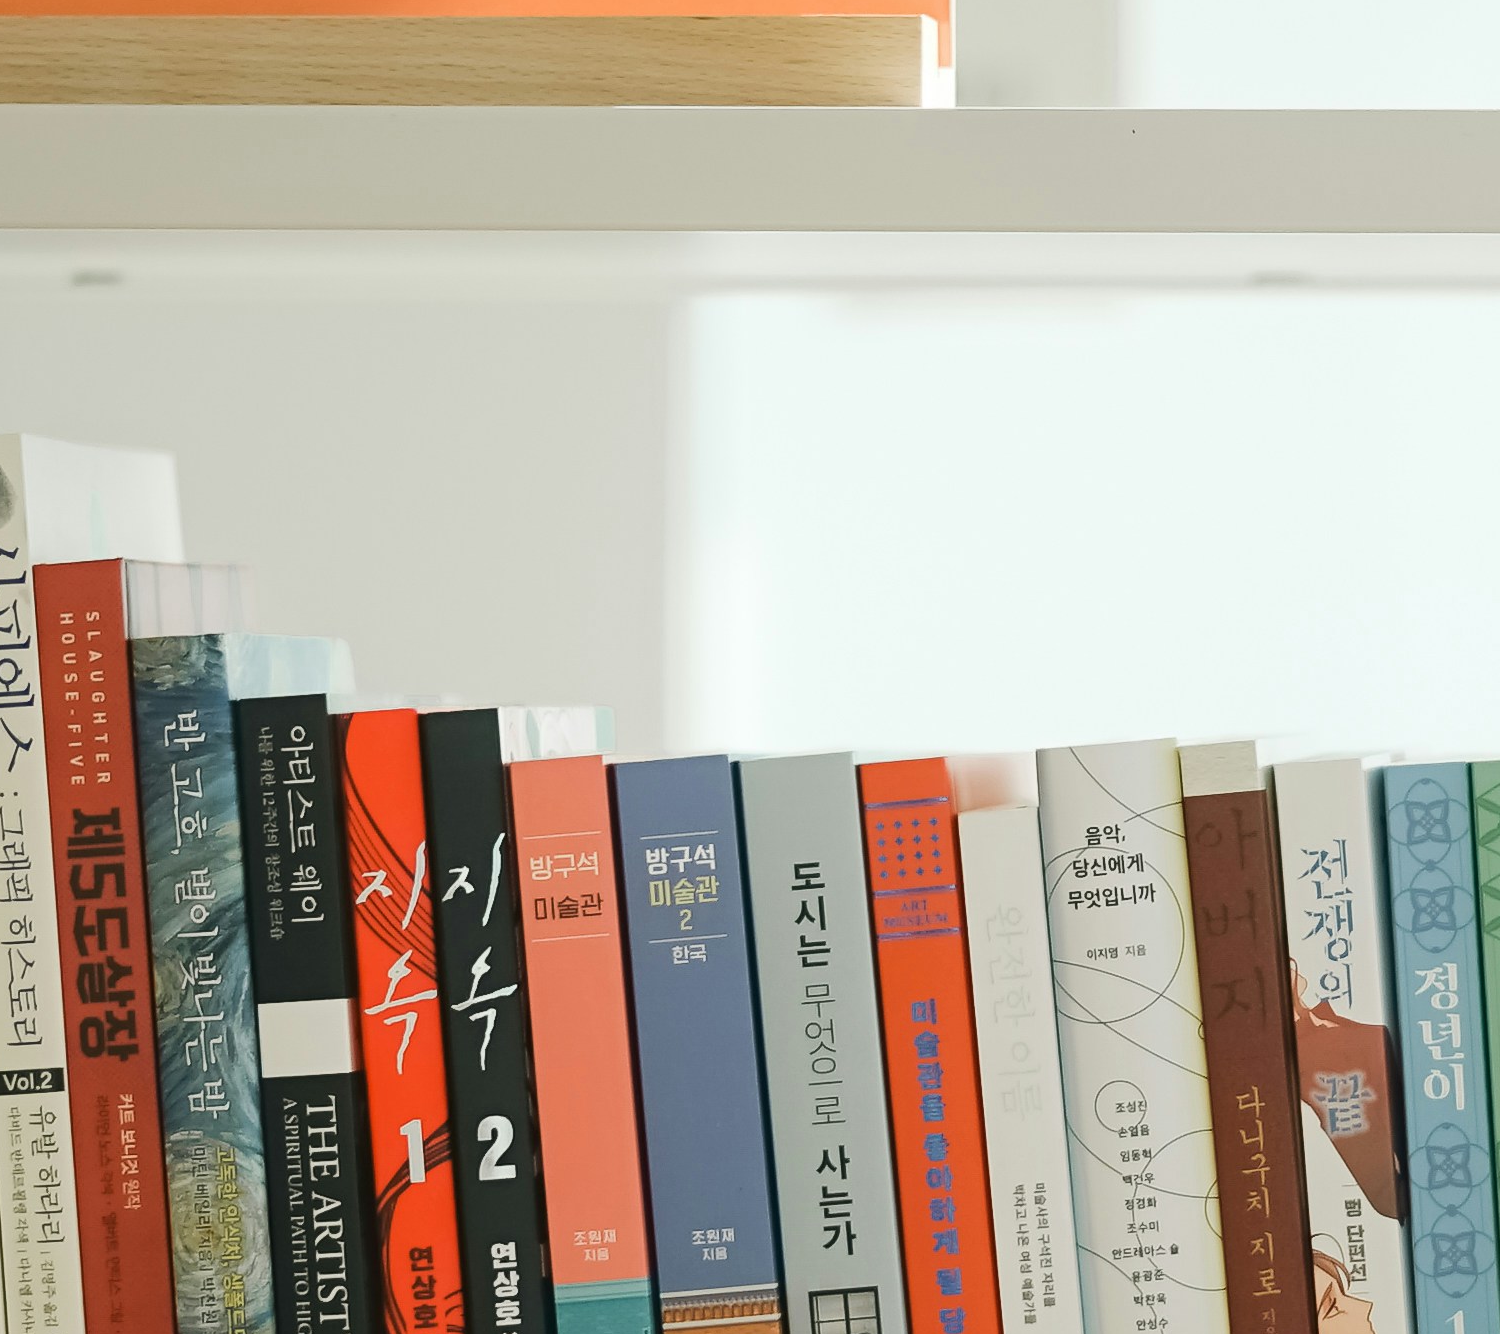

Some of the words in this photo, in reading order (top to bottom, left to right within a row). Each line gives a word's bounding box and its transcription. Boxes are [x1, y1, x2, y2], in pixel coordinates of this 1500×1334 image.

[59, 612, 85, 787] HOUSE-FIVE
[85, 611, 112, 786] SLAUGHTER
[161, 709, 207, 751] 반
[168, 762, 209, 856] 고흐,
[283, 724, 319, 854] 아티스트
[644, 844, 718, 871] 방구석
[1072, 852, 1145, 879] 당신에게
[1085, 824, 1126, 846] 음악,
[289, 865, 325, 925] 웨이
[528, 853, 600, 881] 방구석
[648, 876, 719, 907] 미술관
[1067, 882, 1157, 911] 무엇입니까
[173, 866, 220, 939] 별이
[532, 892, 604, 921] 미술관
[678, 908, 695, 930] 2
[791, 861, 832, 968] 도시는
[1296, 837, 1355, 1010] 전쟁의
[66, 807, 141, 1063] 제5도살장
[354, 841, 438, 1075] 지옥
[441, 832, 518, 1071] 지옥
[671, 945, 708, 965] 한국
[1125, 944, 1147, 957] 지음
[4, 916, 44, 1048] 히스토리
[175, 953, 226, 1070] 빛나는
[801, 983, 846, 1126] 무엇으로
[1414, 961, 1466, 1111] 정년이
[1, 1072, 55, 1093] Vol.2
[118, 1093, 138, 1126] 커트
[186, 1081, 231, 1119] 밤
[282, 1097, 297, 1110] A
[1313, 1073, 1370, 1133] 끝
[120, 1129, 141, 1175] 보니것
[284, 1113, 305, 1211] SPIRITUAL
[305, 1094, 340, 1178] THE
[398, 1120, 427, 1184] 1
[476, 1115, 517, 1180] 2
[1235, 1084, 1274, 1220] 다니구치
[123, 1179, 142, 1211] 원작
[815, 1144, 858, 1257] 사는가
[288, 1214, 311, 1264] PATH
[1126, 1221, 1161, 1234] 조수미
[293, 1267, 313, 1297] TO
[409, 1247, 439, 1329] 연상호
[1250, 1230, 1283, 1299] 지로
